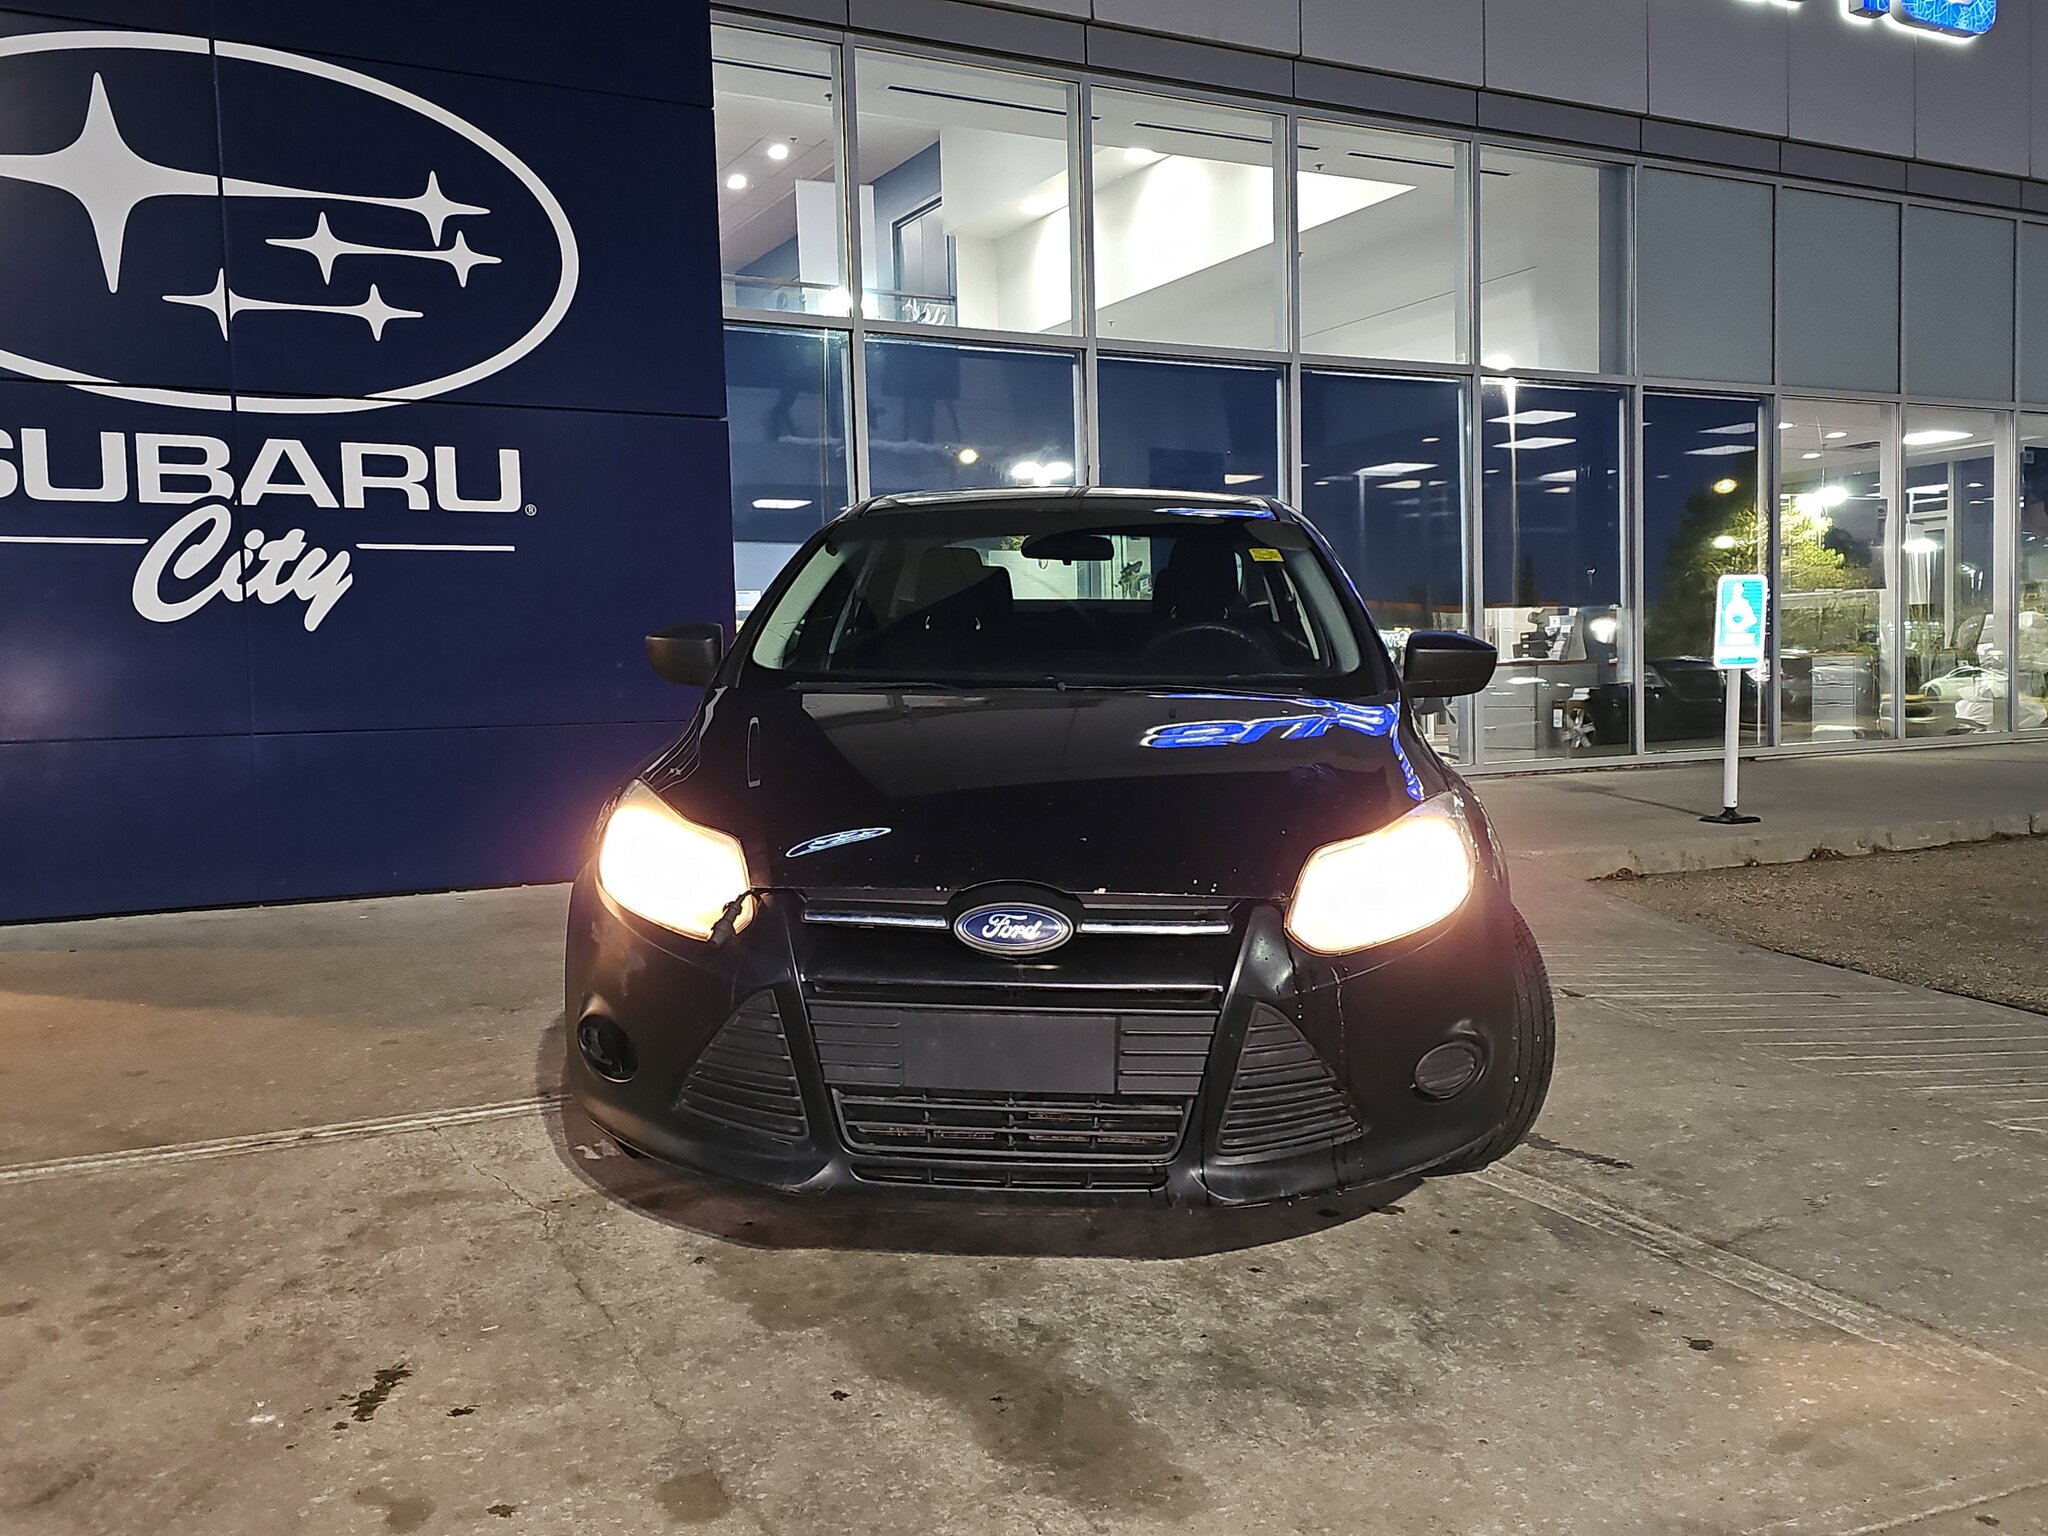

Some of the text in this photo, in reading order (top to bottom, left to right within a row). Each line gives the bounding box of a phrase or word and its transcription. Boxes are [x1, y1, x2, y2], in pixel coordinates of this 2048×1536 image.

[0, 428, 521, 512] UBARU
[132, 504, 353, 632] City
[982, 913, 1043, 940] Ford
